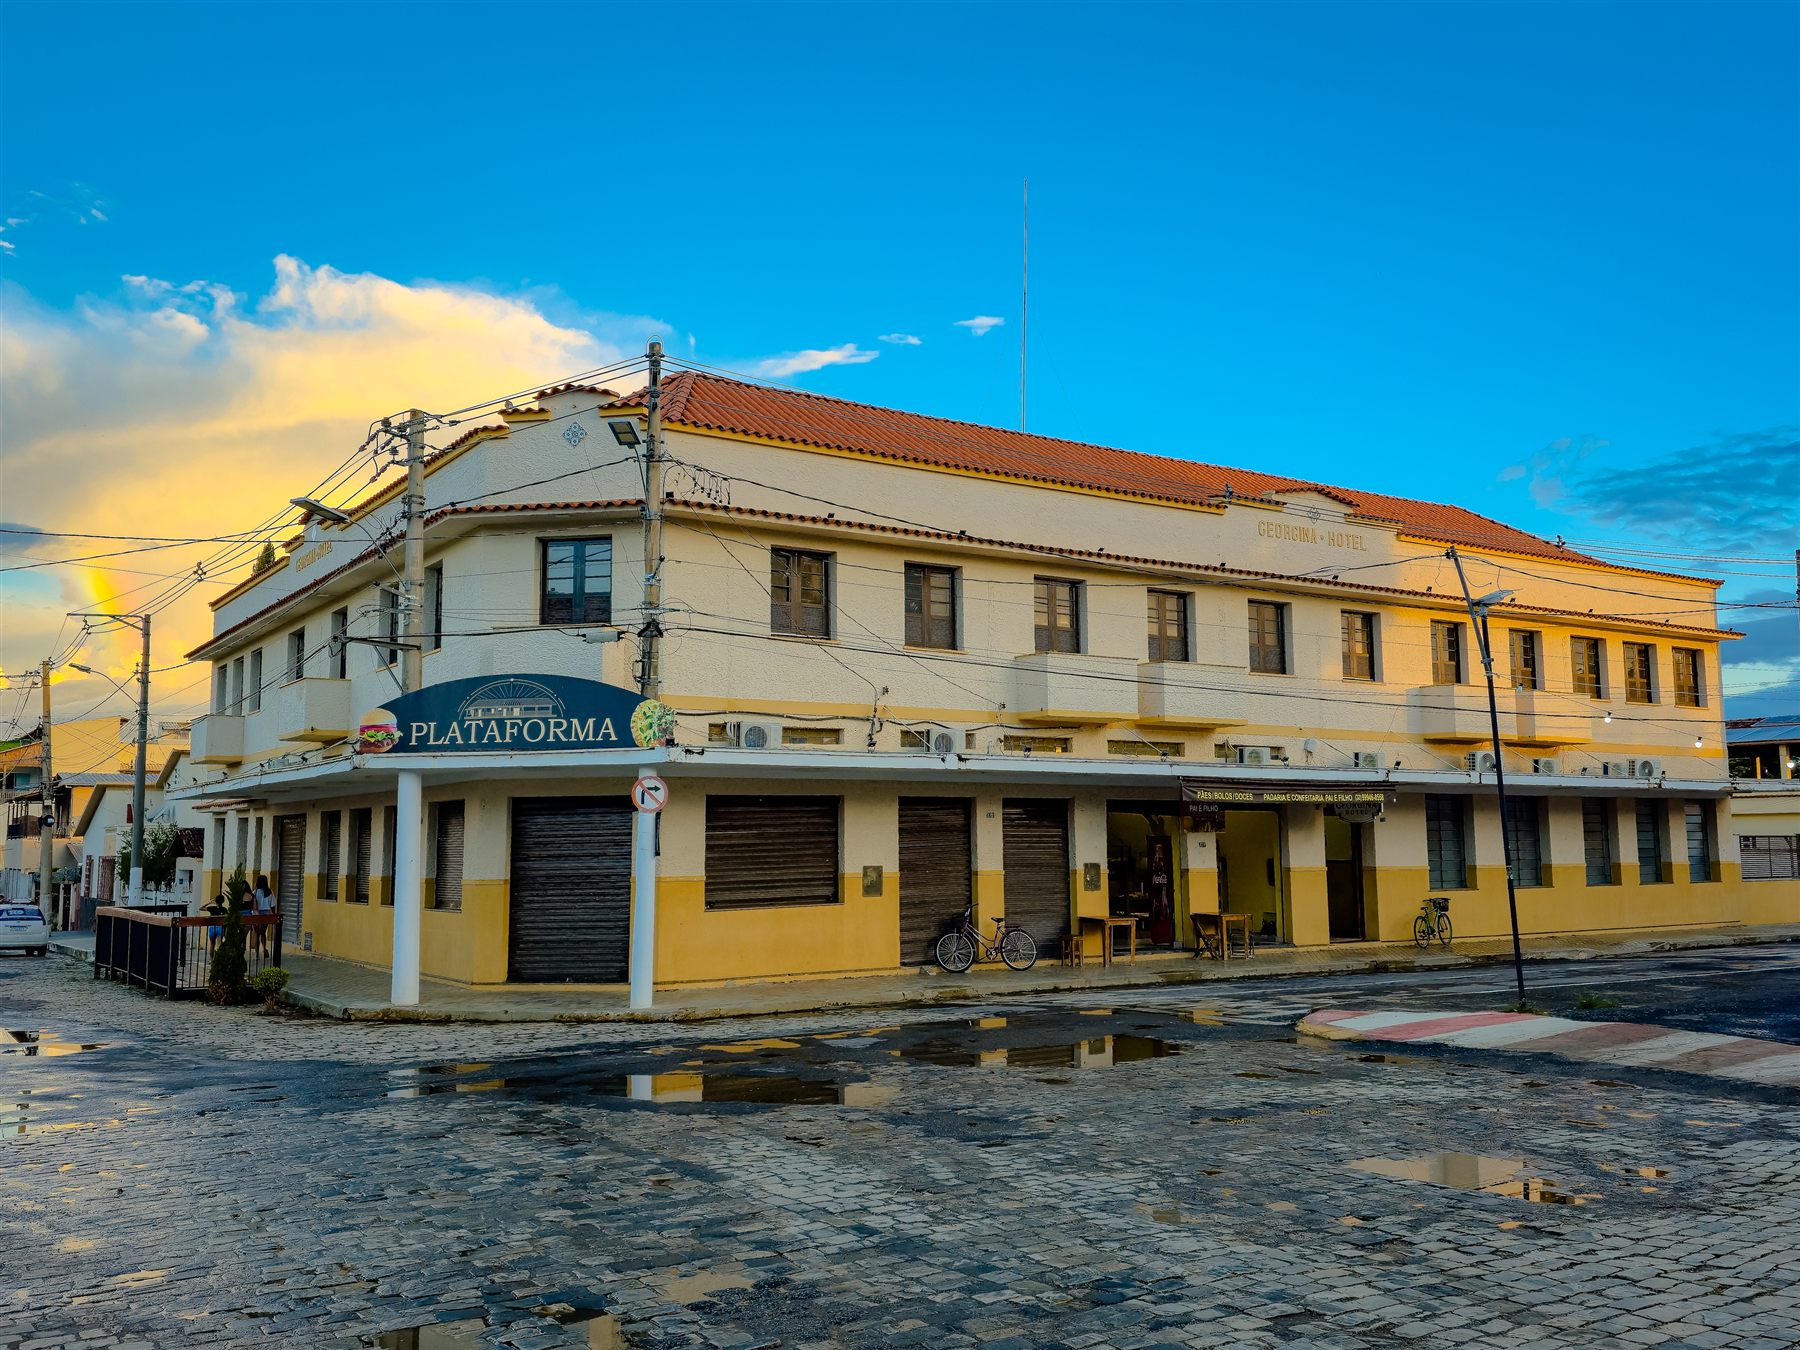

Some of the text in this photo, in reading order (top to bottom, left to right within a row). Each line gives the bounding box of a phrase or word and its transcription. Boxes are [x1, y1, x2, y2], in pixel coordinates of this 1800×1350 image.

[1257, 520, 1367, 551] GEORGINA HOTEL
[409, 718, 618, 746] PLATAFORMA
[1263, 793, 1287, 801] PADARIA
[1291, 794, 1324, 802] CONFEITARIA
[1338, 794, 1353, 802] FILHO
[1203, 804, 1218, 812] FILHO
